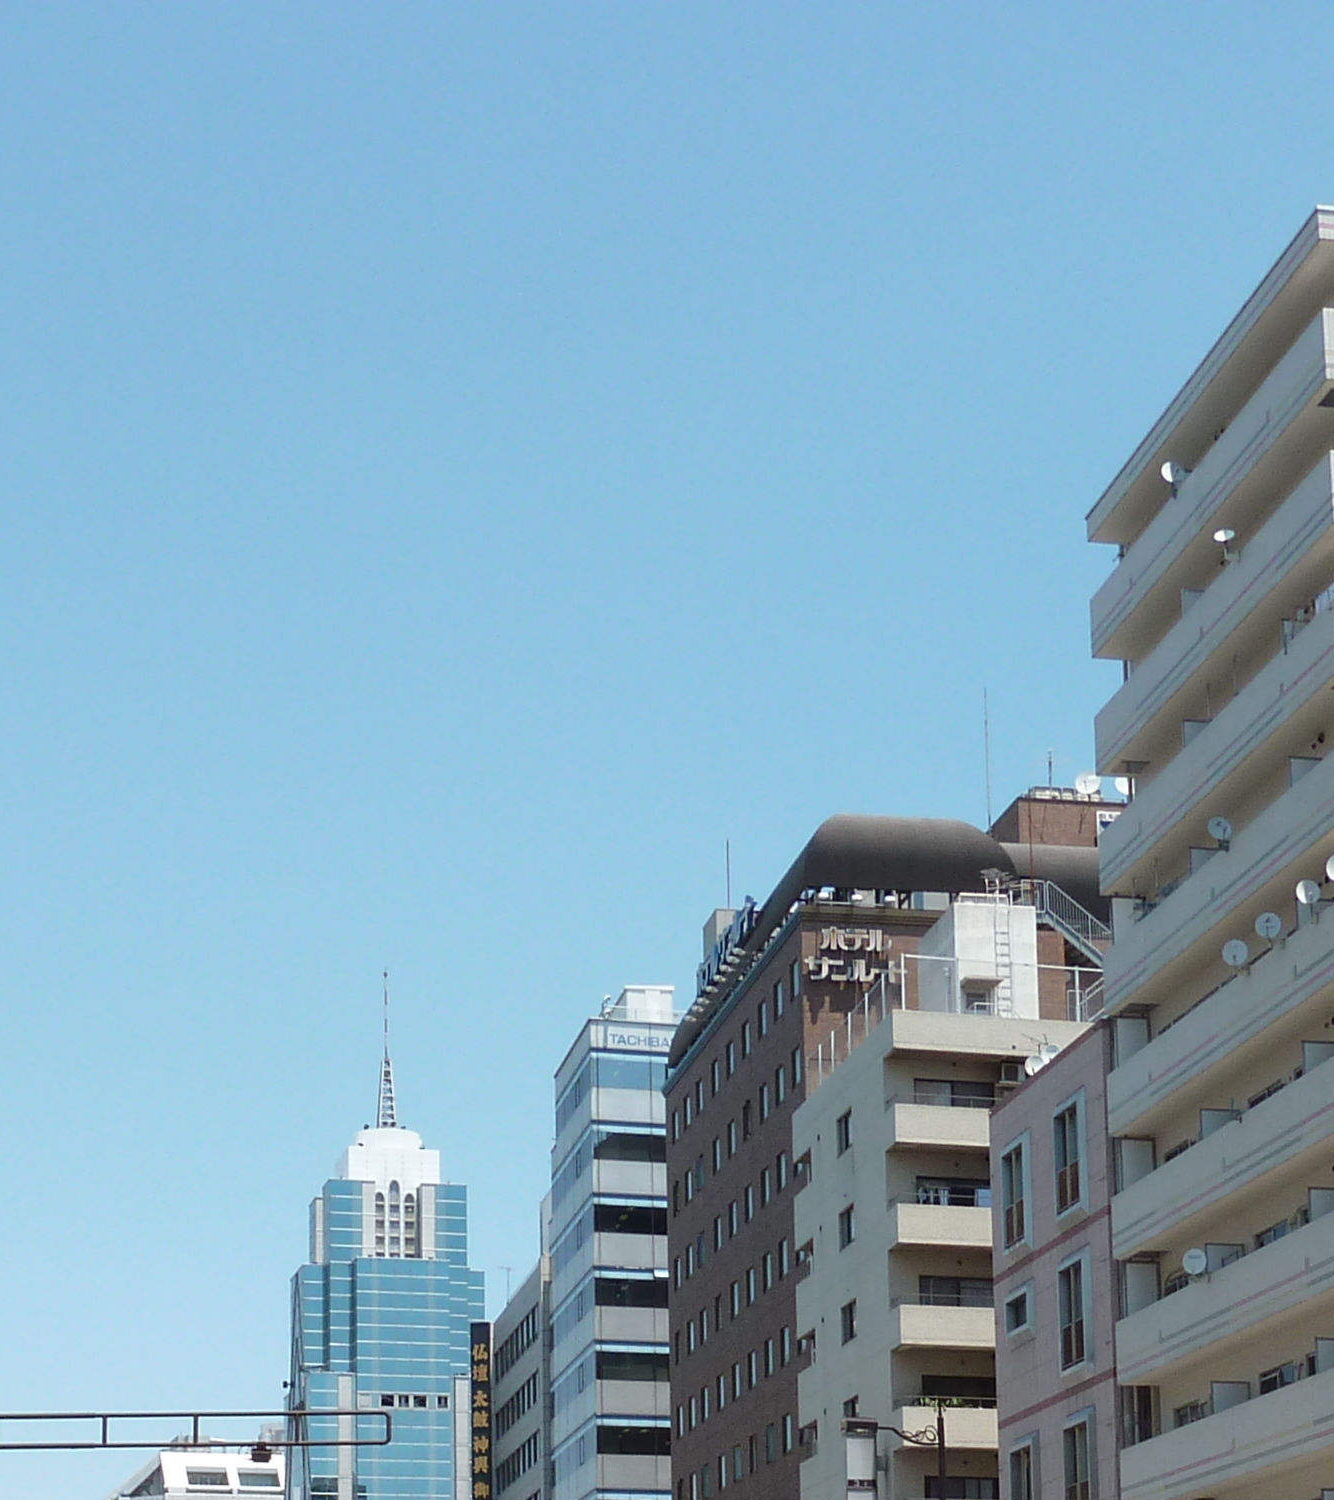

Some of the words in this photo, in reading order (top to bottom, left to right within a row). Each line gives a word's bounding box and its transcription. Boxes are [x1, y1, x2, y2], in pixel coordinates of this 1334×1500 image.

[820, 926, 892, 952] ホテル
[804, 956, 907, 984] サンルート
